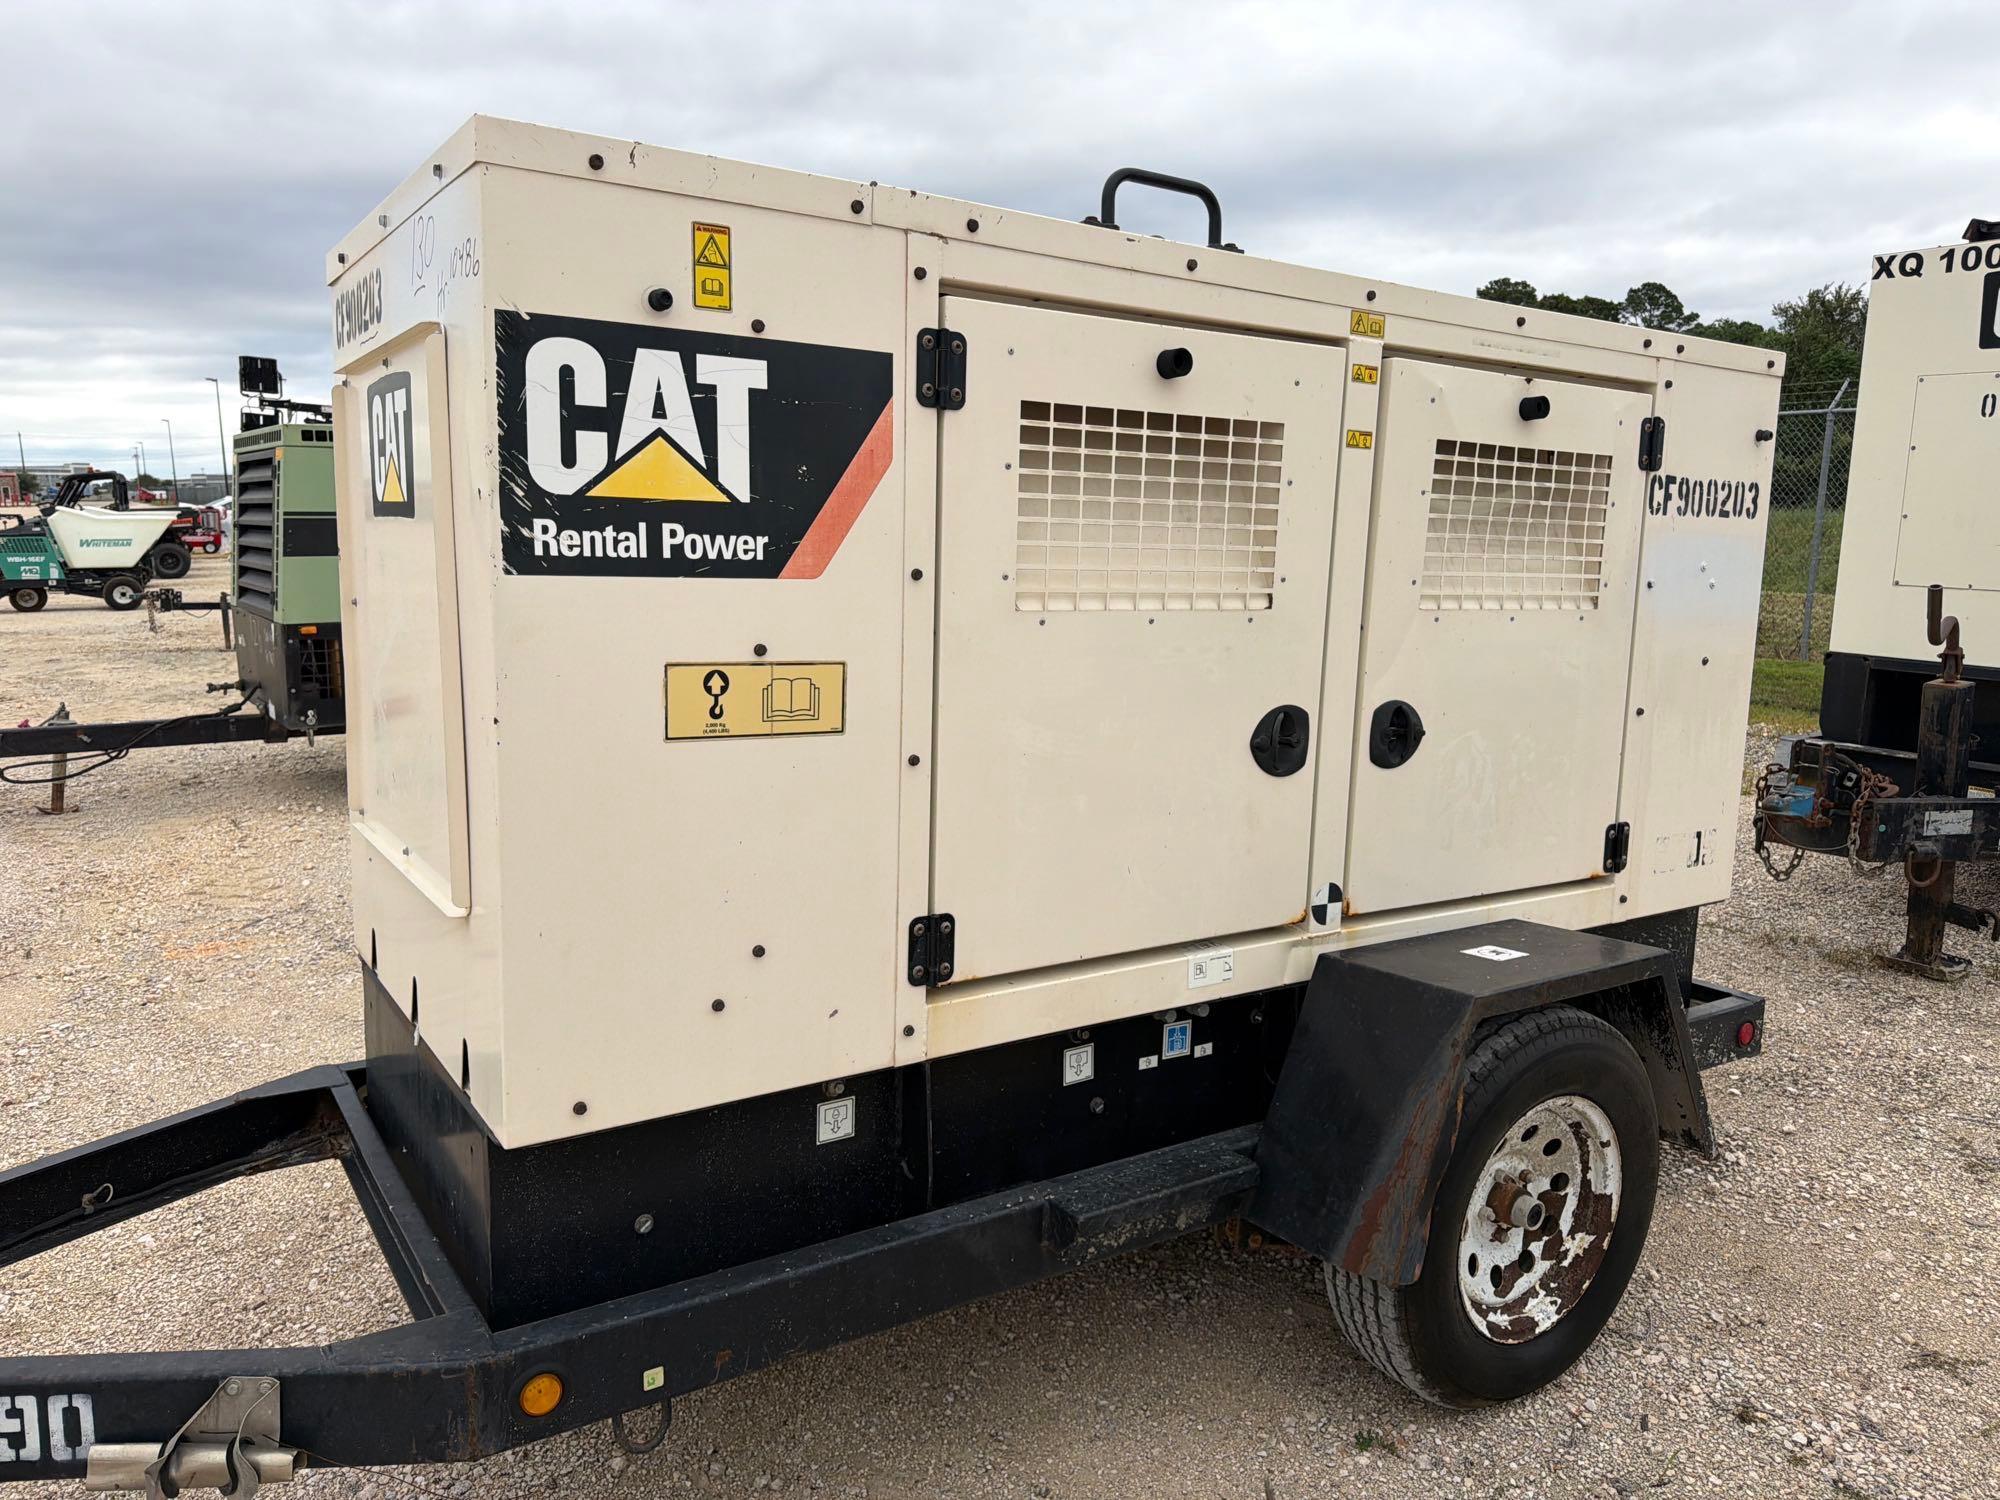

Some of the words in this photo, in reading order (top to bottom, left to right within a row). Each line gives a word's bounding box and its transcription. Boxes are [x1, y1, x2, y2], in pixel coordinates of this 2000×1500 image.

[412, 215, 435, 286] 130
[449, 237, 480, 279] 10486
[1872, 252, 1924, 281] XQ
[335, 268, 383, 350] CF900203
[525, 336, 768, 503] CAT
[372, 387, 408, 502] CAT
[1648, 474, 1760, 519] CF900203
[79, 538, 133, 547] WHITEMAN
[533, 518, 648, 559] Rental
[662, 522, 769, 561] Power
